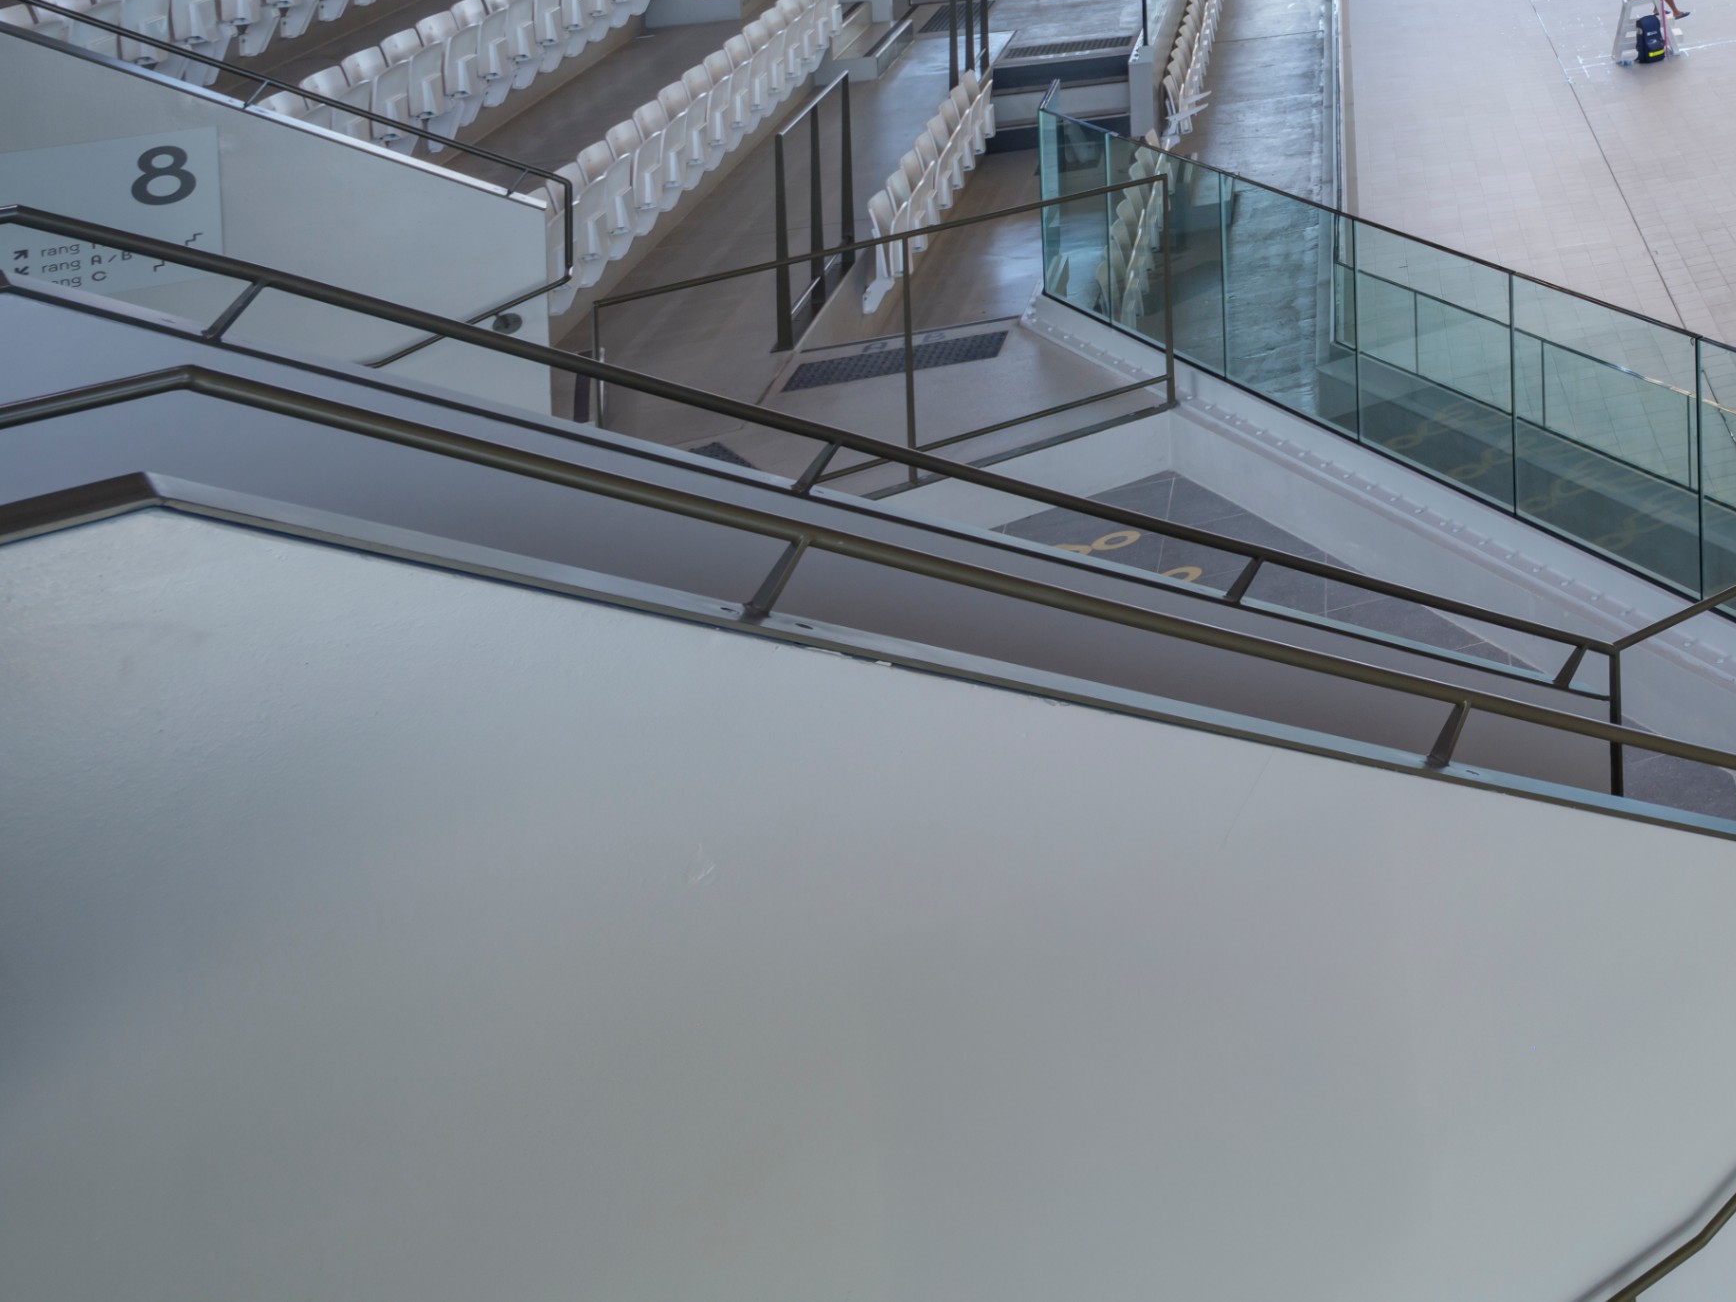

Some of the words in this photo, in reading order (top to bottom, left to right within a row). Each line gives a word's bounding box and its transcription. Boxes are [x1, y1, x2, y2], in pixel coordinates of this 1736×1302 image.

[131, 145, 197, 206] 8
[41, 243, 80, 257] rang
[42, 259, 81, 273] rang
[91, 254, 102, 266] A
[91, 271, 107, 282] C
